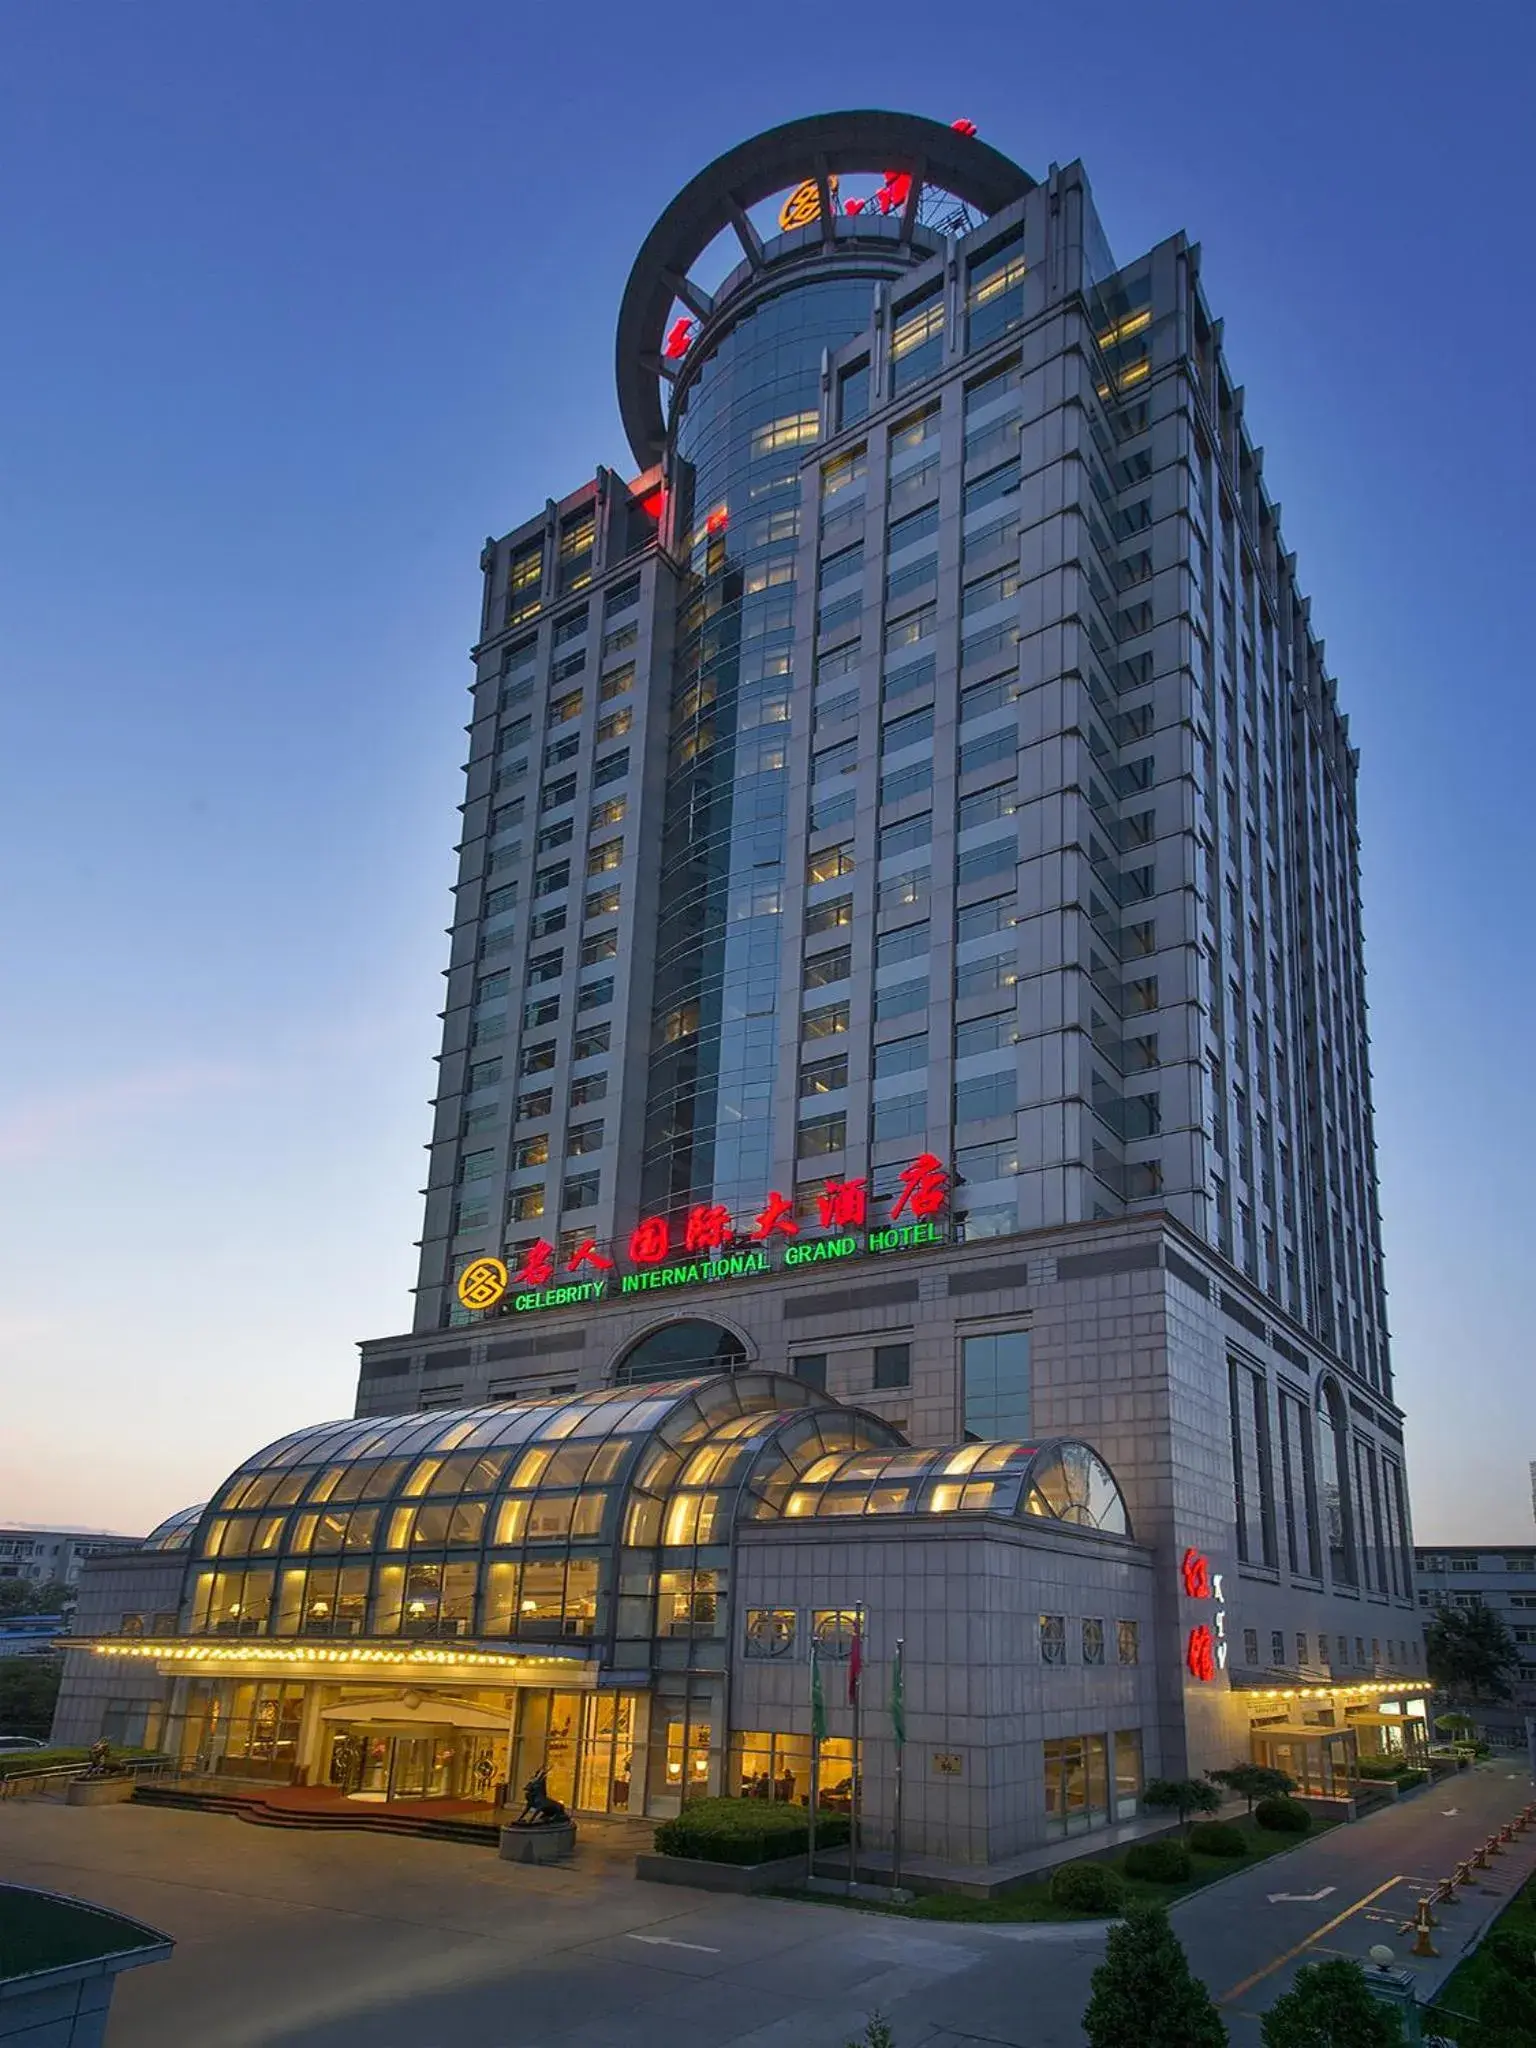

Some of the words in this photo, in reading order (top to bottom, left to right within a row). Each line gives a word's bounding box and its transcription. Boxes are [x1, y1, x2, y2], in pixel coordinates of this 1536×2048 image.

[513, 1153, 947, 1287] 名人国际大酒店
[514, 1280, 604, 1312] CELEBRITY
[621, 1252, 768, 1293] INTERNATIONAL
[784, 1236, 857, 1265] GRAND
[868, 1221, 943, 1252] HOTEL
[1213, 1574, 1228, 1670] KTV
